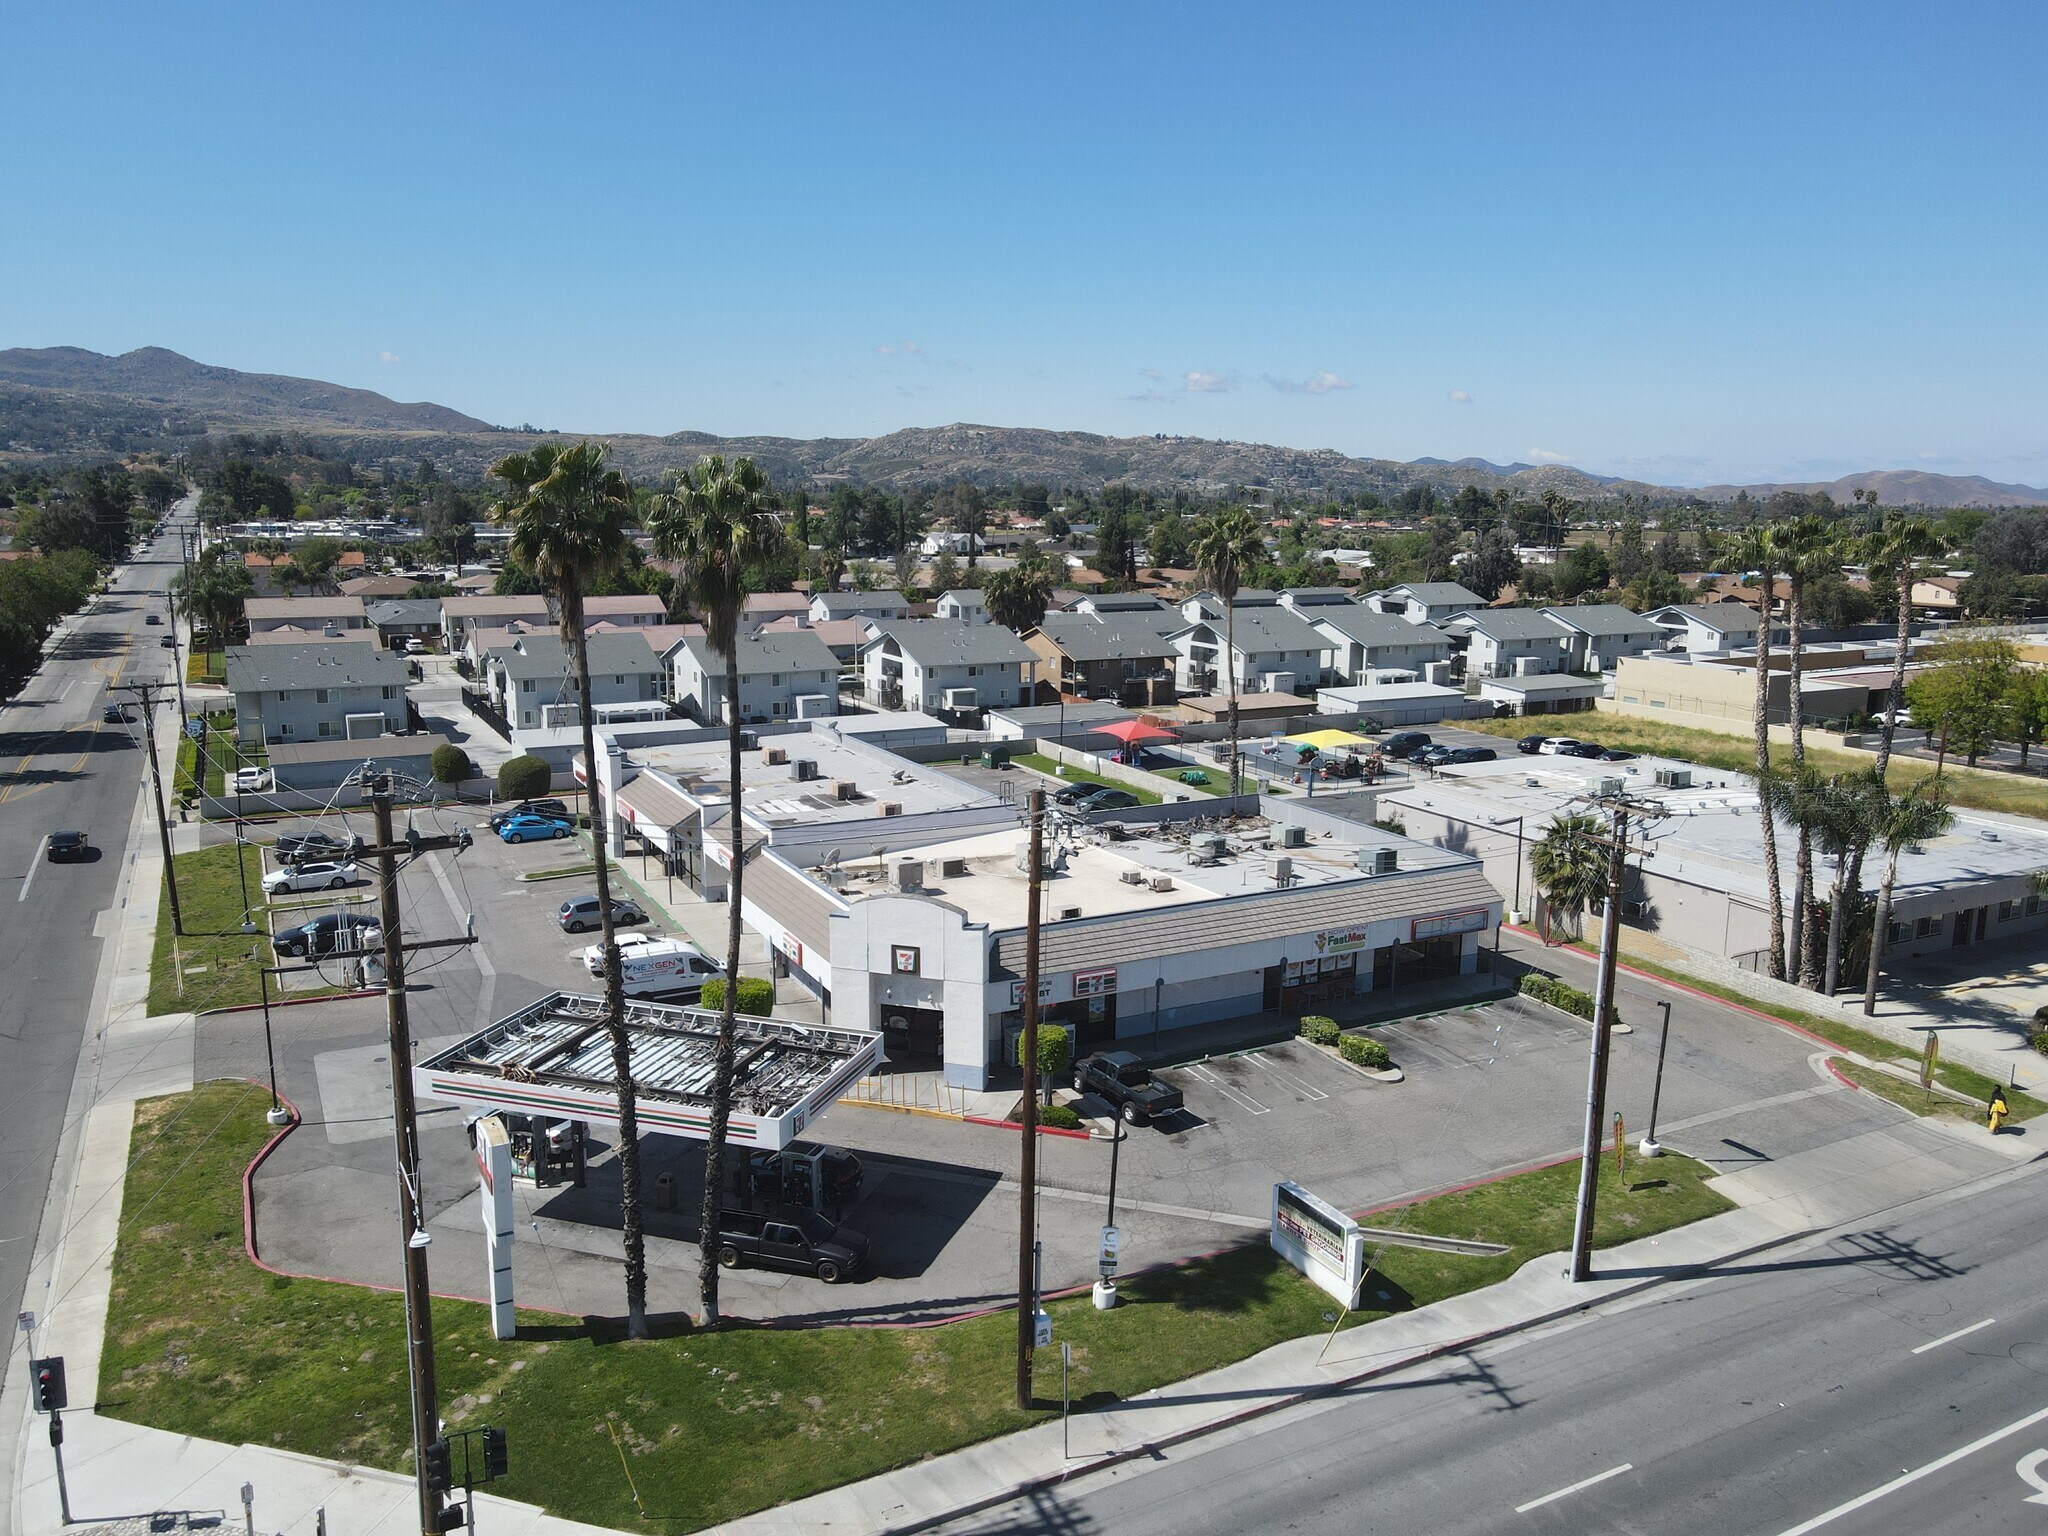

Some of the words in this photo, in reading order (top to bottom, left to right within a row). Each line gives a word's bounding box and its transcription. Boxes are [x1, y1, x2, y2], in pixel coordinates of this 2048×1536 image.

[1328, 928, 1345, 936] NOW
[1328, 932, 1366, 946] FastMex
[633, 960, 676, 972] NEXGEN
[1307, 1225, 1343, 1253] VETERINARIAN
